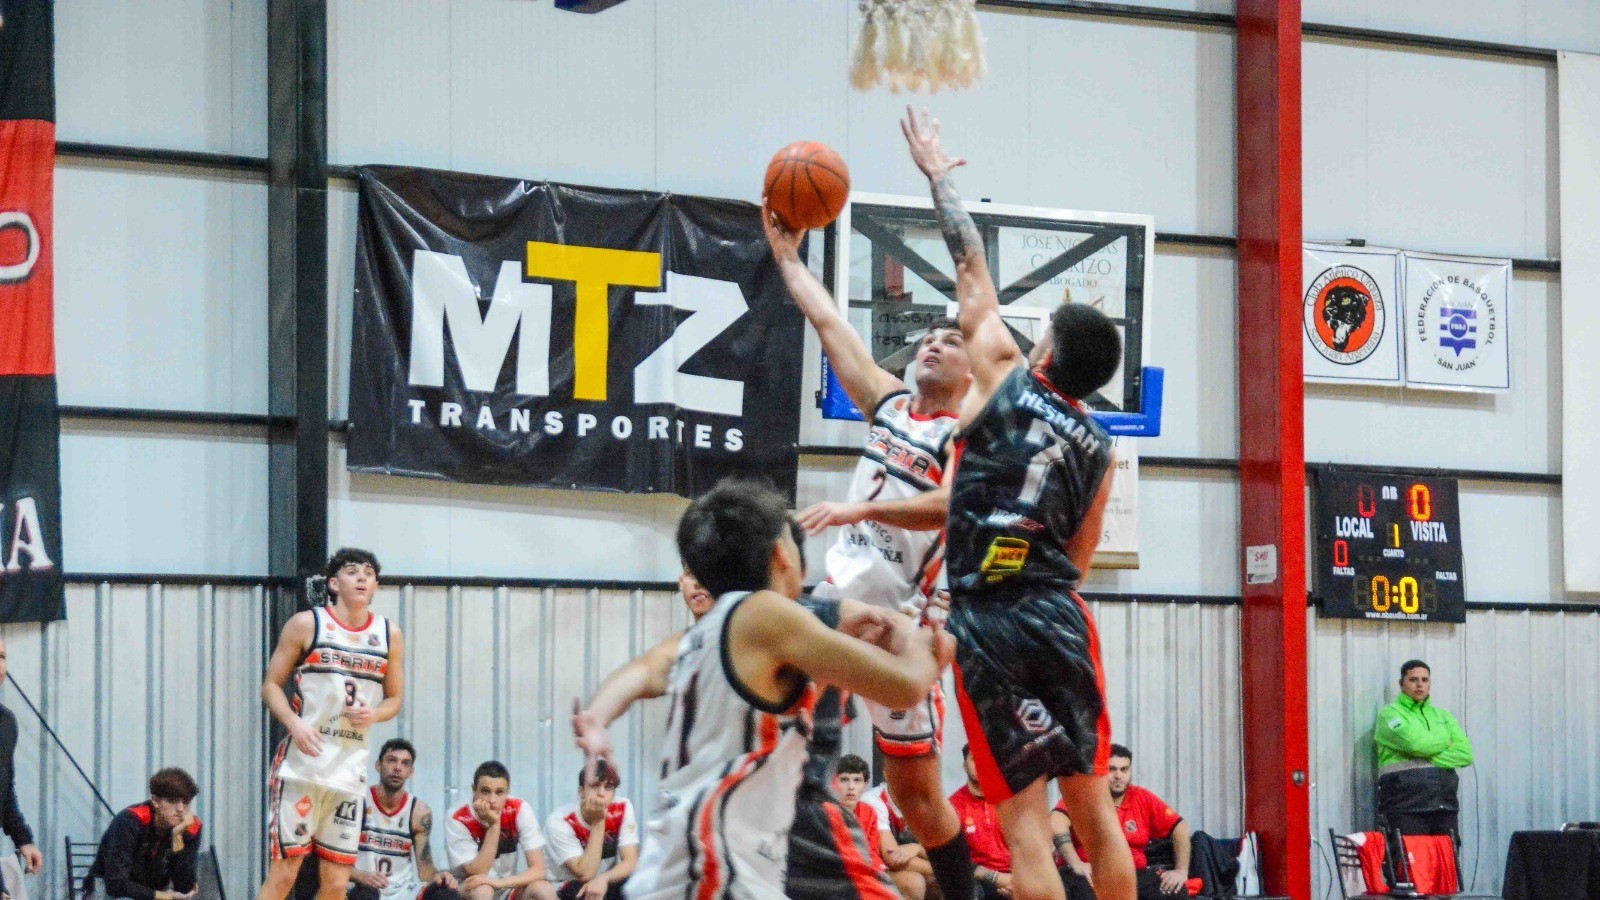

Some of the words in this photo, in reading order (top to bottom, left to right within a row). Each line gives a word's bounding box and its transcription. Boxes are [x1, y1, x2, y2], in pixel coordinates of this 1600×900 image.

[1306, 283, 1323, 307] Club
[1322, 267, 1359, 286] Atlético
[1360, 274, 1382, 311] Urquiza
[1447, 275, 1460, 284] DE
[1462, 278, 1496, 345] BASQUETBOL
[408, 240, 750, 417] MTZ
[1309, 327, 1322, 348] San
[1323, 345, 1343, 361] Juan
[1344, 331, 1380, 361] Argentina
[1436, 357, 1454, 370] SAN
[1455, 360, 1476, 371] JUAN
[408, 399, 744, 451] TRANSPORTES
[1410, 484, 1431, 521] 0
[1335, 515, 1375, 539] LOCAL
[1393, 523, 1400, 548] 1
[1410, 520, 1448, 543] VISITA
[1333, 539, 1349, 567] 0
[1382, 548, 1405, 558] CUARTO
[1332, 566, 1355, 576] FALTAS
[1435, 570, 1457, 581] FALTAS
[1371, 575, 1419, 614] 0:0
[1365, 611, 1428, 620] www.nbaudio.com.ar
